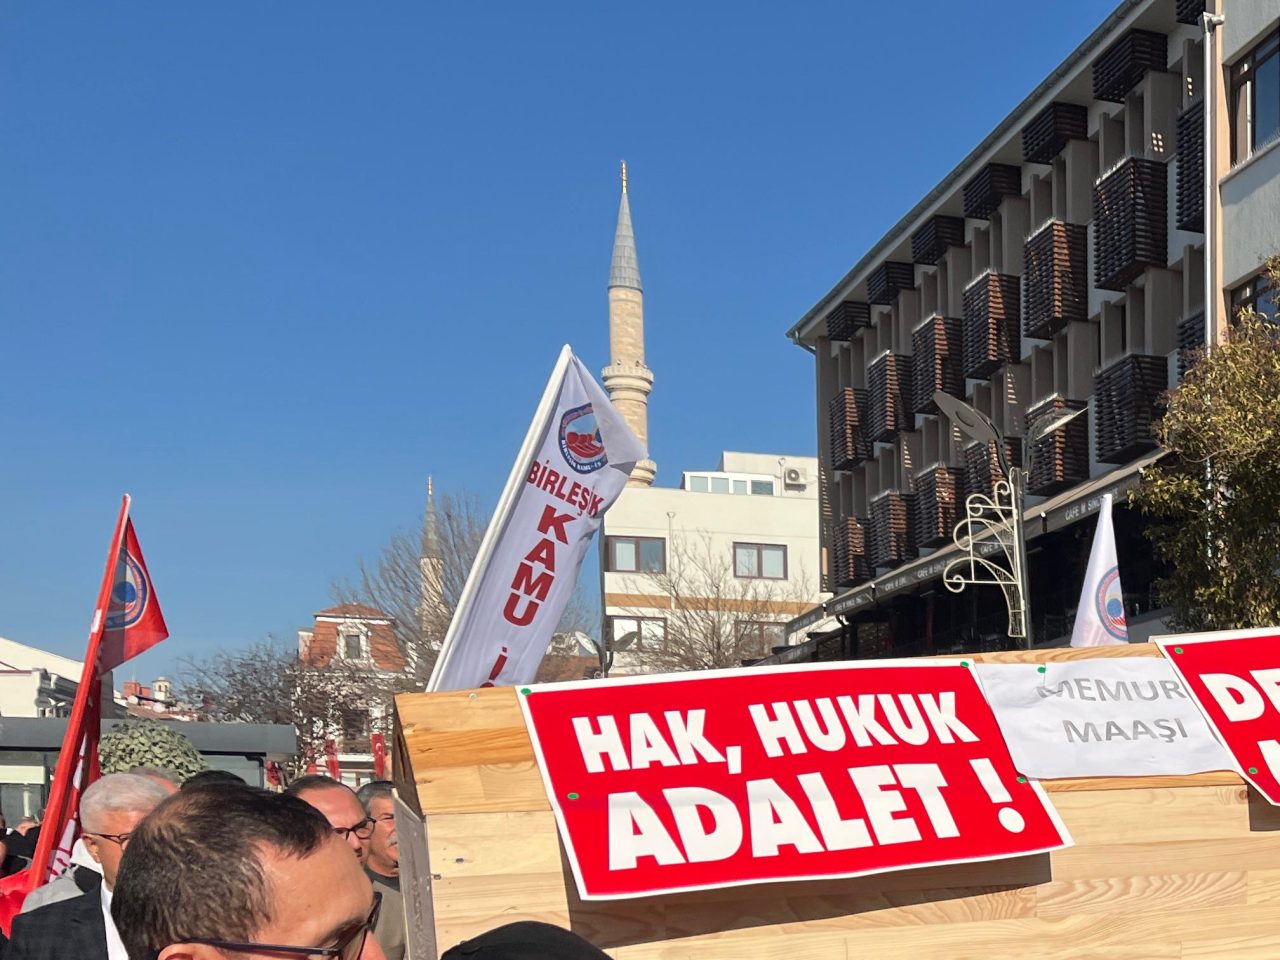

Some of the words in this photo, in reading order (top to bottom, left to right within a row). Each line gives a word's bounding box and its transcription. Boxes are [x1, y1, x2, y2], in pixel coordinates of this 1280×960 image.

[503, 504, 577, 627] KAMU
[1036, 678, 1188, 702] MEMUR
[1062, 718, 1188, 743] MAAŞI
[572, 709, 742, 775] HAK,
[748, 691, 981, 758] HUKUK
[608, 763, 961, 872] ADALET
